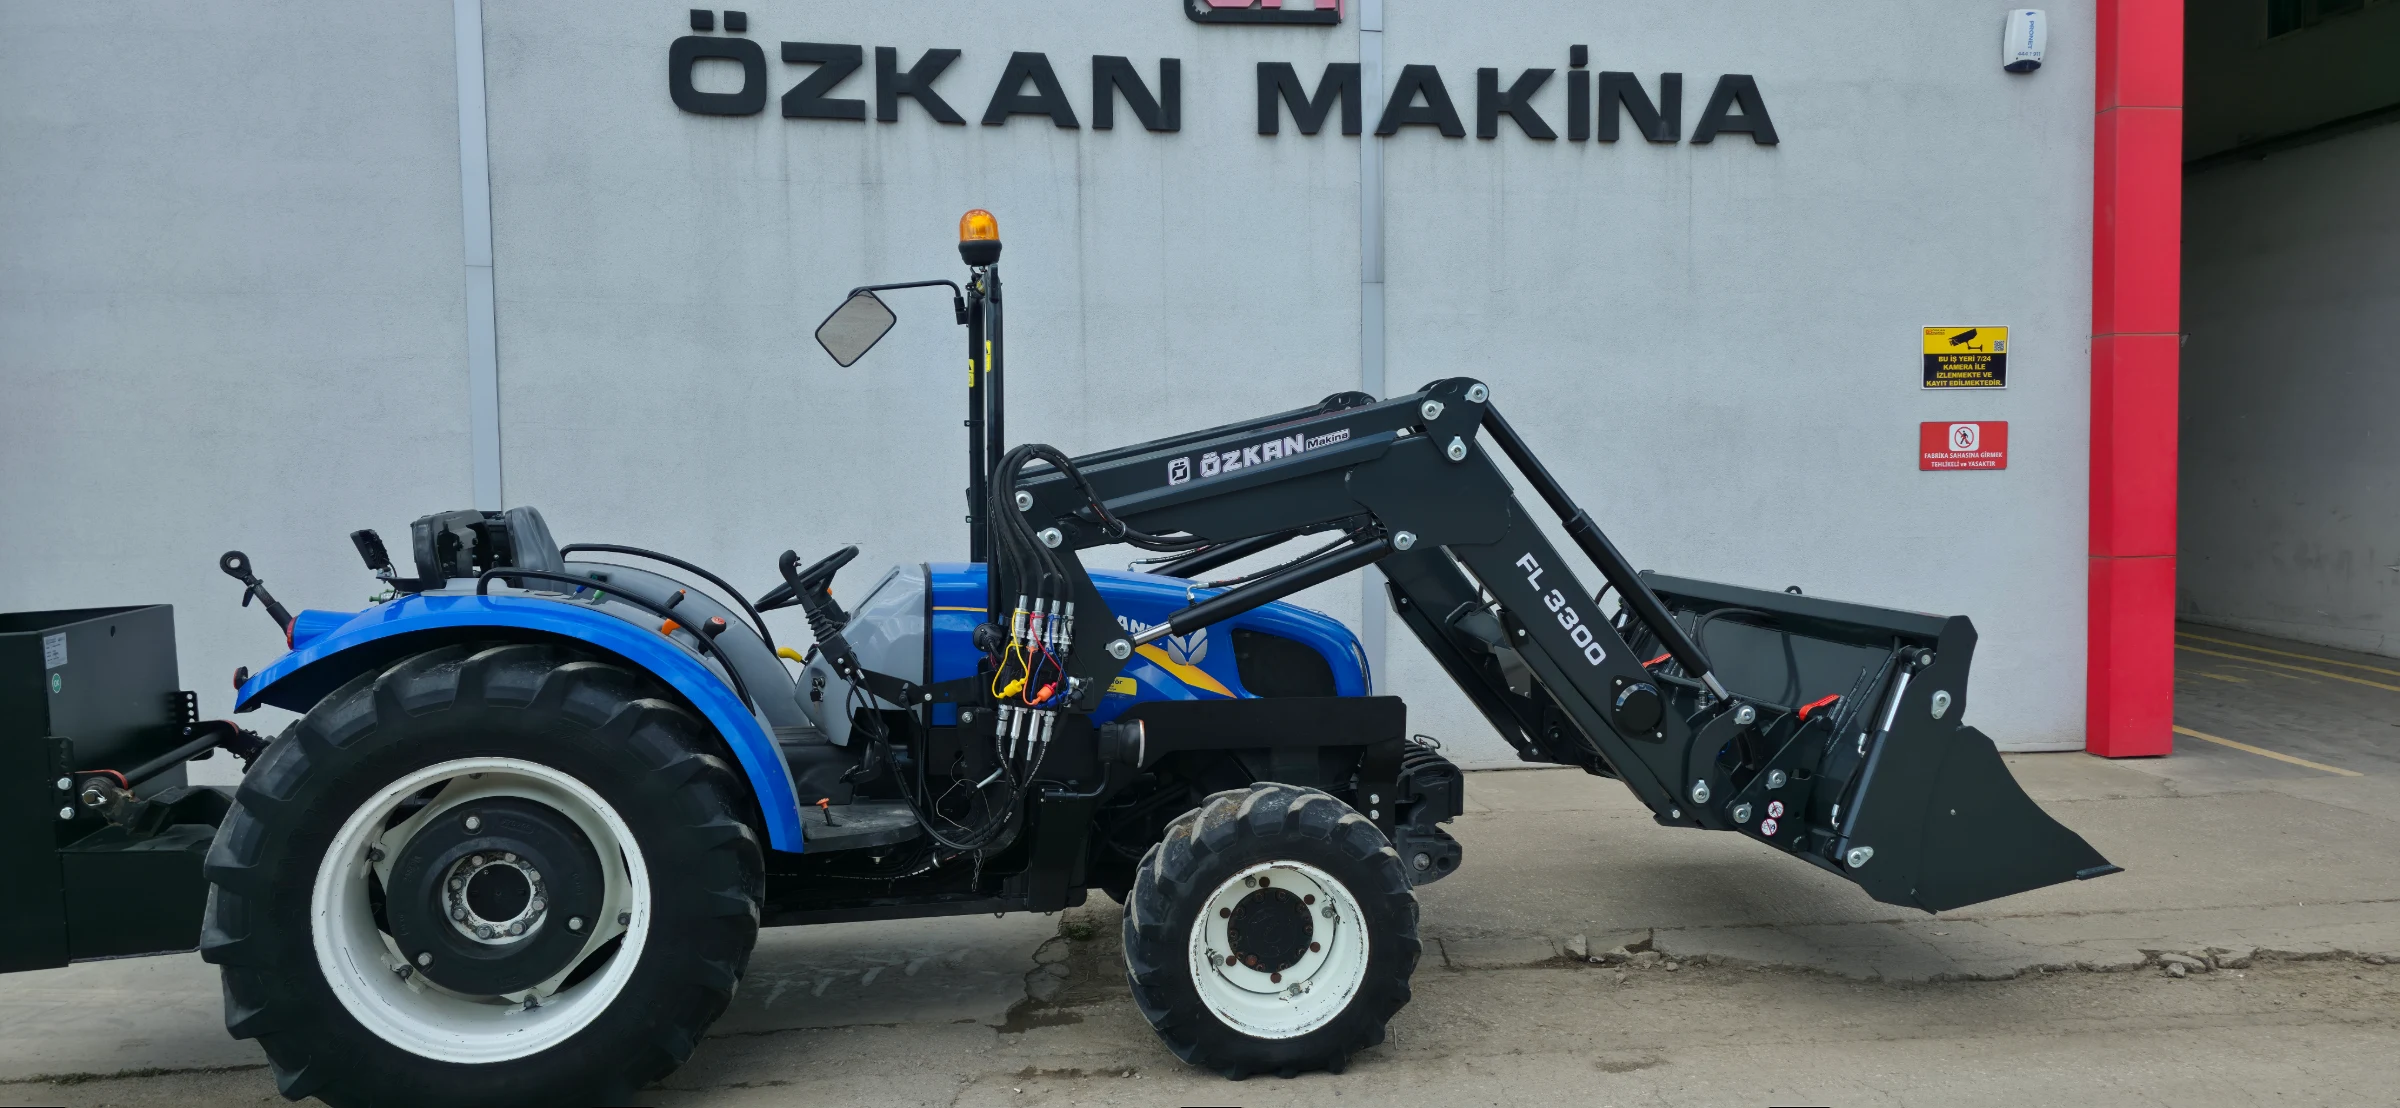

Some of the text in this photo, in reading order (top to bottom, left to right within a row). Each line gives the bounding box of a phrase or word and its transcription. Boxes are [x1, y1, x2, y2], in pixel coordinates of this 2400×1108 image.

[669, 8, 1780, 146] ÖZKAN MAKİNA
[1949, 379, 2003, 387] EDİLMEKTEDİR.
[1950, 355, 1957, 363] İŞ
[1200, 433, 1305, 478] ÖZKAN
[1307, 429, 1349, 449] Makina
[1516, 552, 1607, 666] FL 3300
